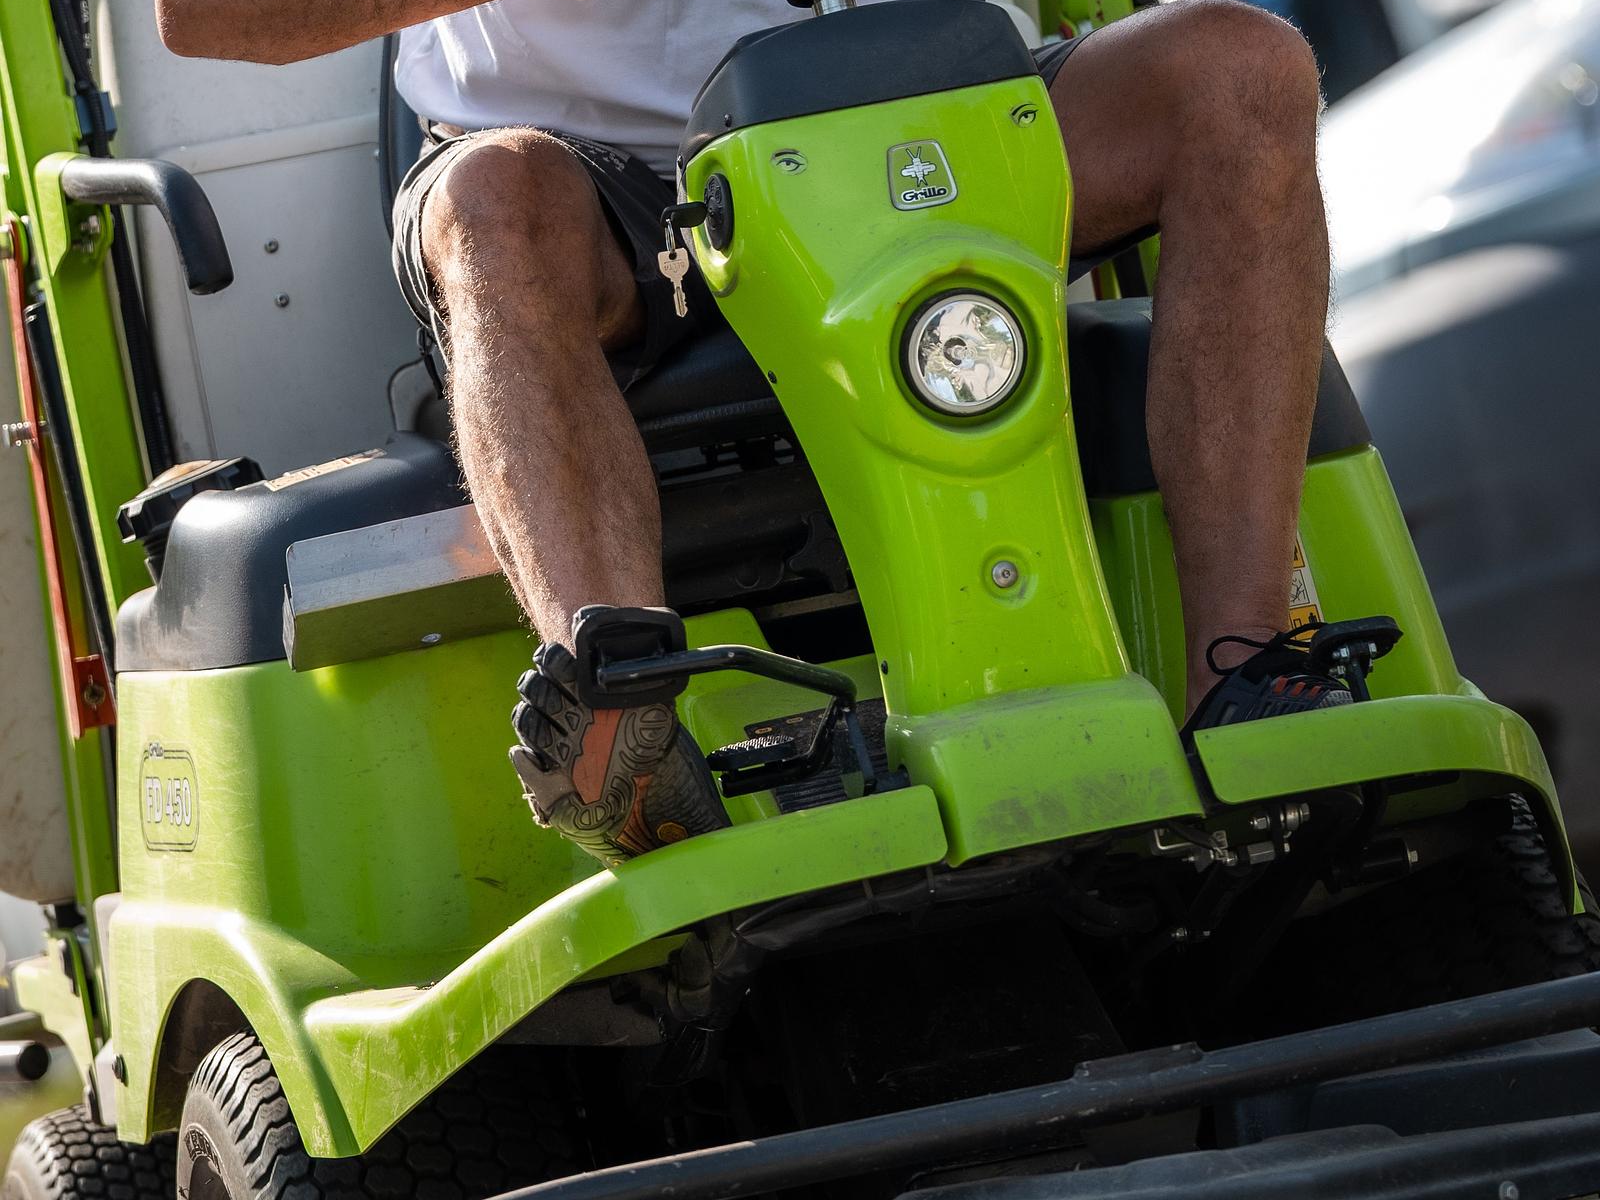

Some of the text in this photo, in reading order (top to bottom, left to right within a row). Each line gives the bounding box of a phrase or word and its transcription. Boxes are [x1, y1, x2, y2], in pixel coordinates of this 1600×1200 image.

[902, 187, 948, 202] Grillo
[145, 775, 191, 826] FD 450
